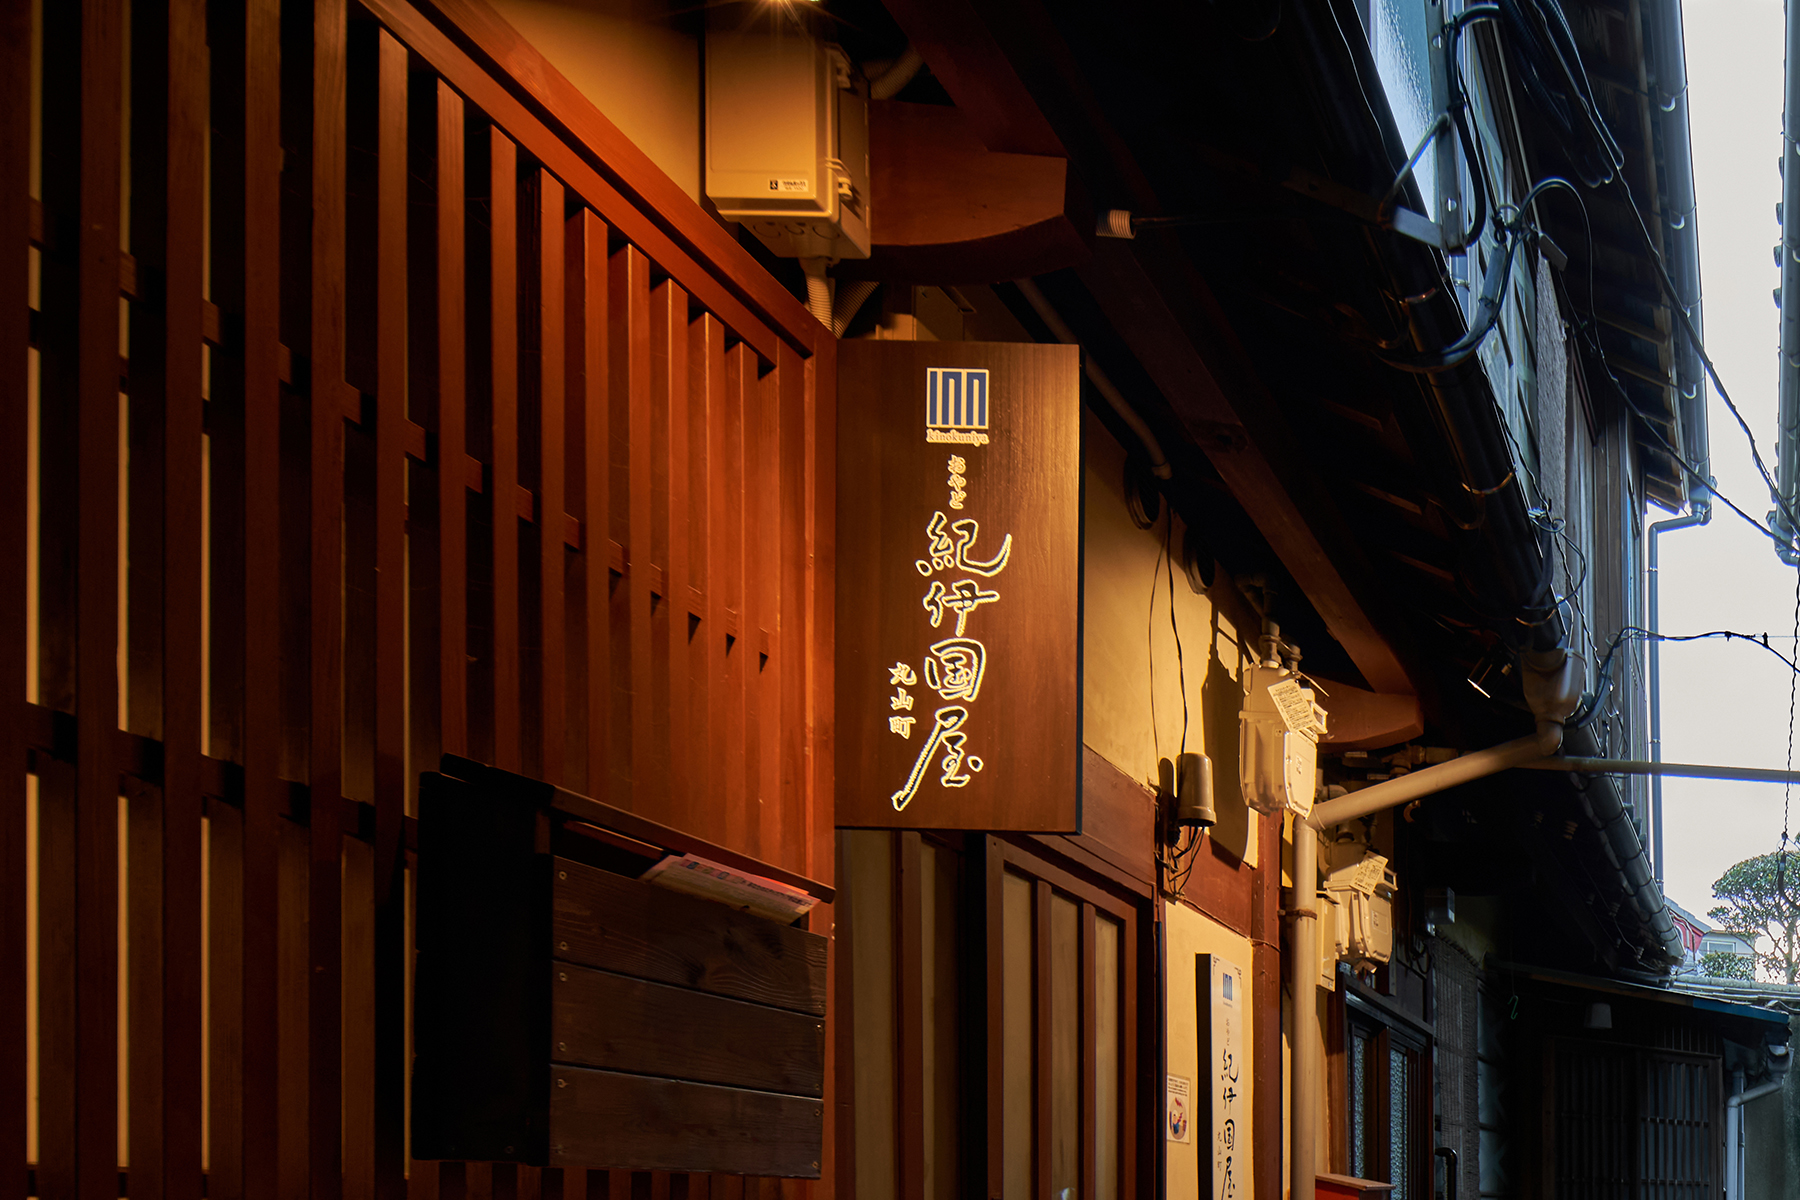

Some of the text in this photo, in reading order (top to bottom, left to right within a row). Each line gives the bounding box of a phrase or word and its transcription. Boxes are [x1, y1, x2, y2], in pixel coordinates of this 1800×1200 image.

[926, 428, 989, 447] kinokuniya
[947, 454, 967, 509] おやど
[891, 511, 1012, 812] 紀伊国屋
[888, 662, 917, 739] 丸山町
